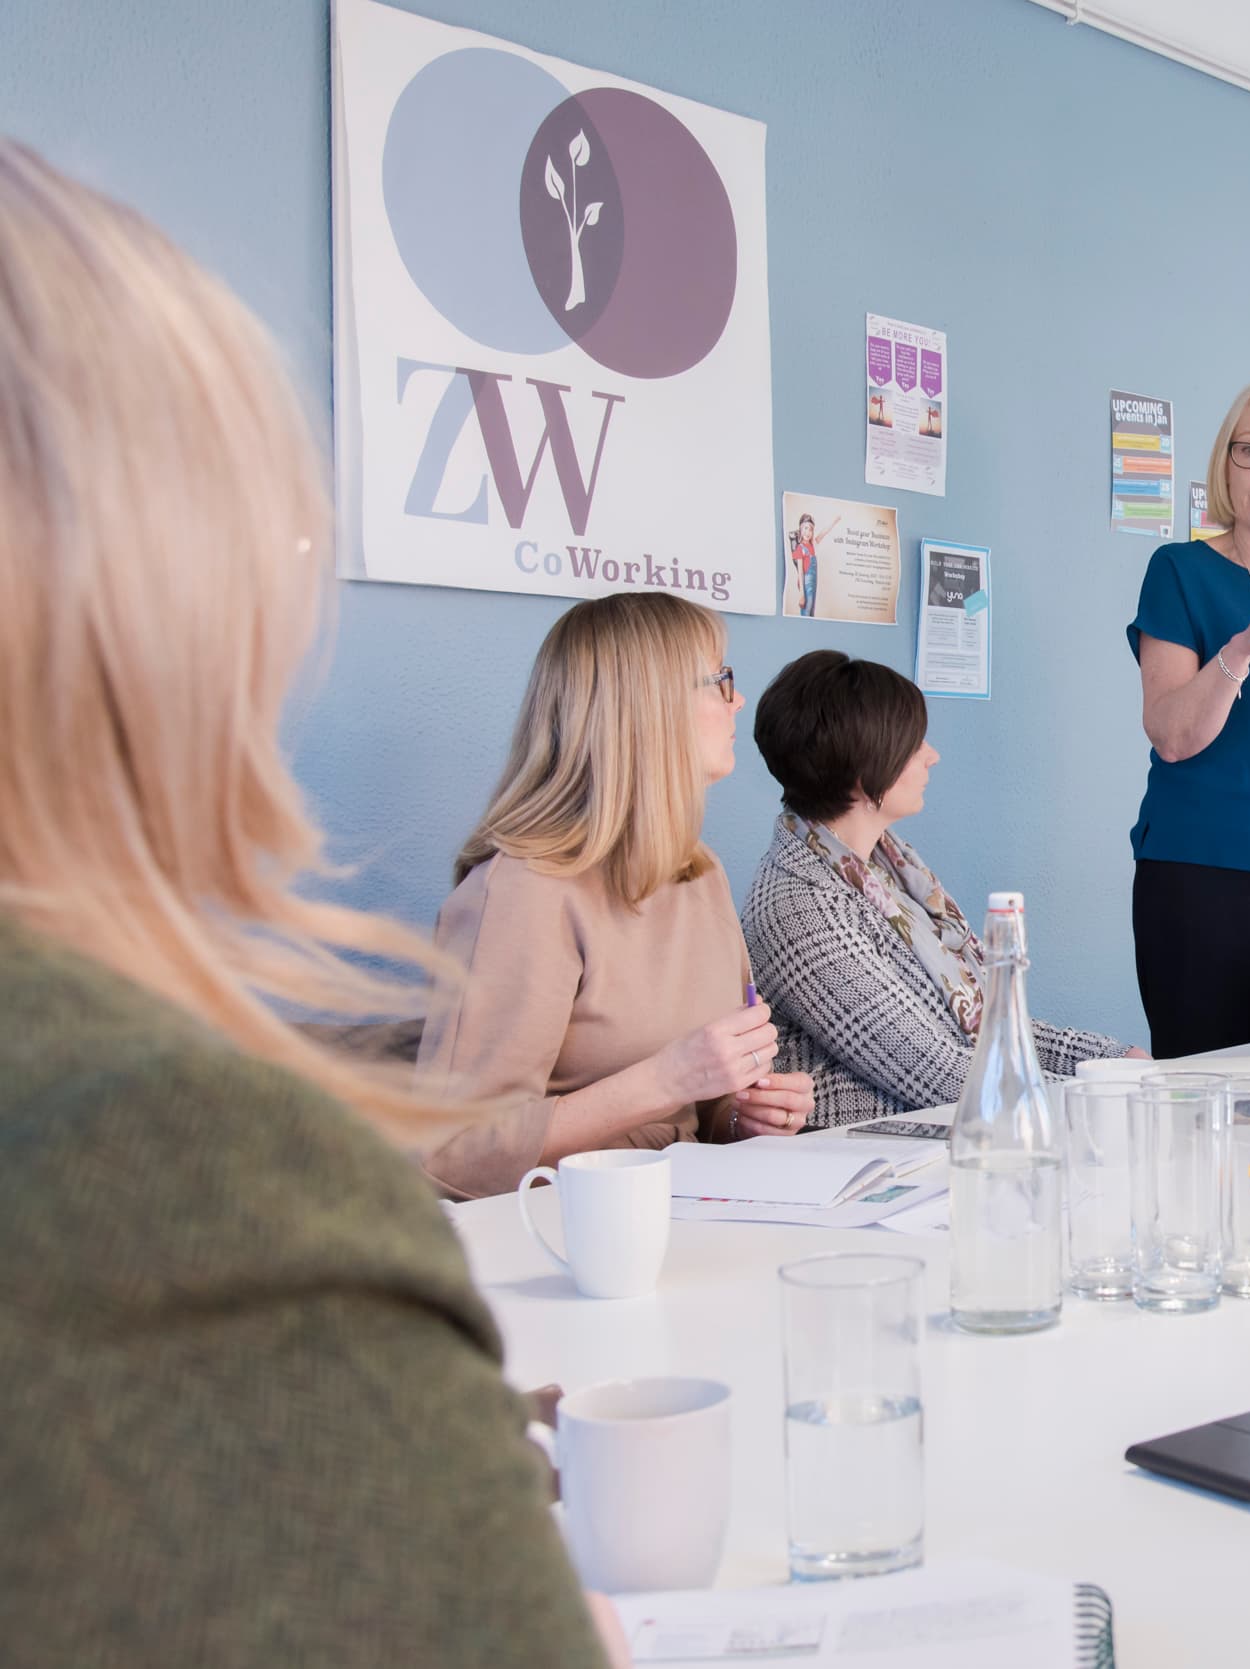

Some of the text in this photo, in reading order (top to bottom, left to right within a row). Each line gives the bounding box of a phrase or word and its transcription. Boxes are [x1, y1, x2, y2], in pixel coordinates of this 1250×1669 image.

[1112, 399, 1164, 416] UPCOMING
[1115, 412, 1144, 423] events
[514, 540, 732, 601] CoWorking
